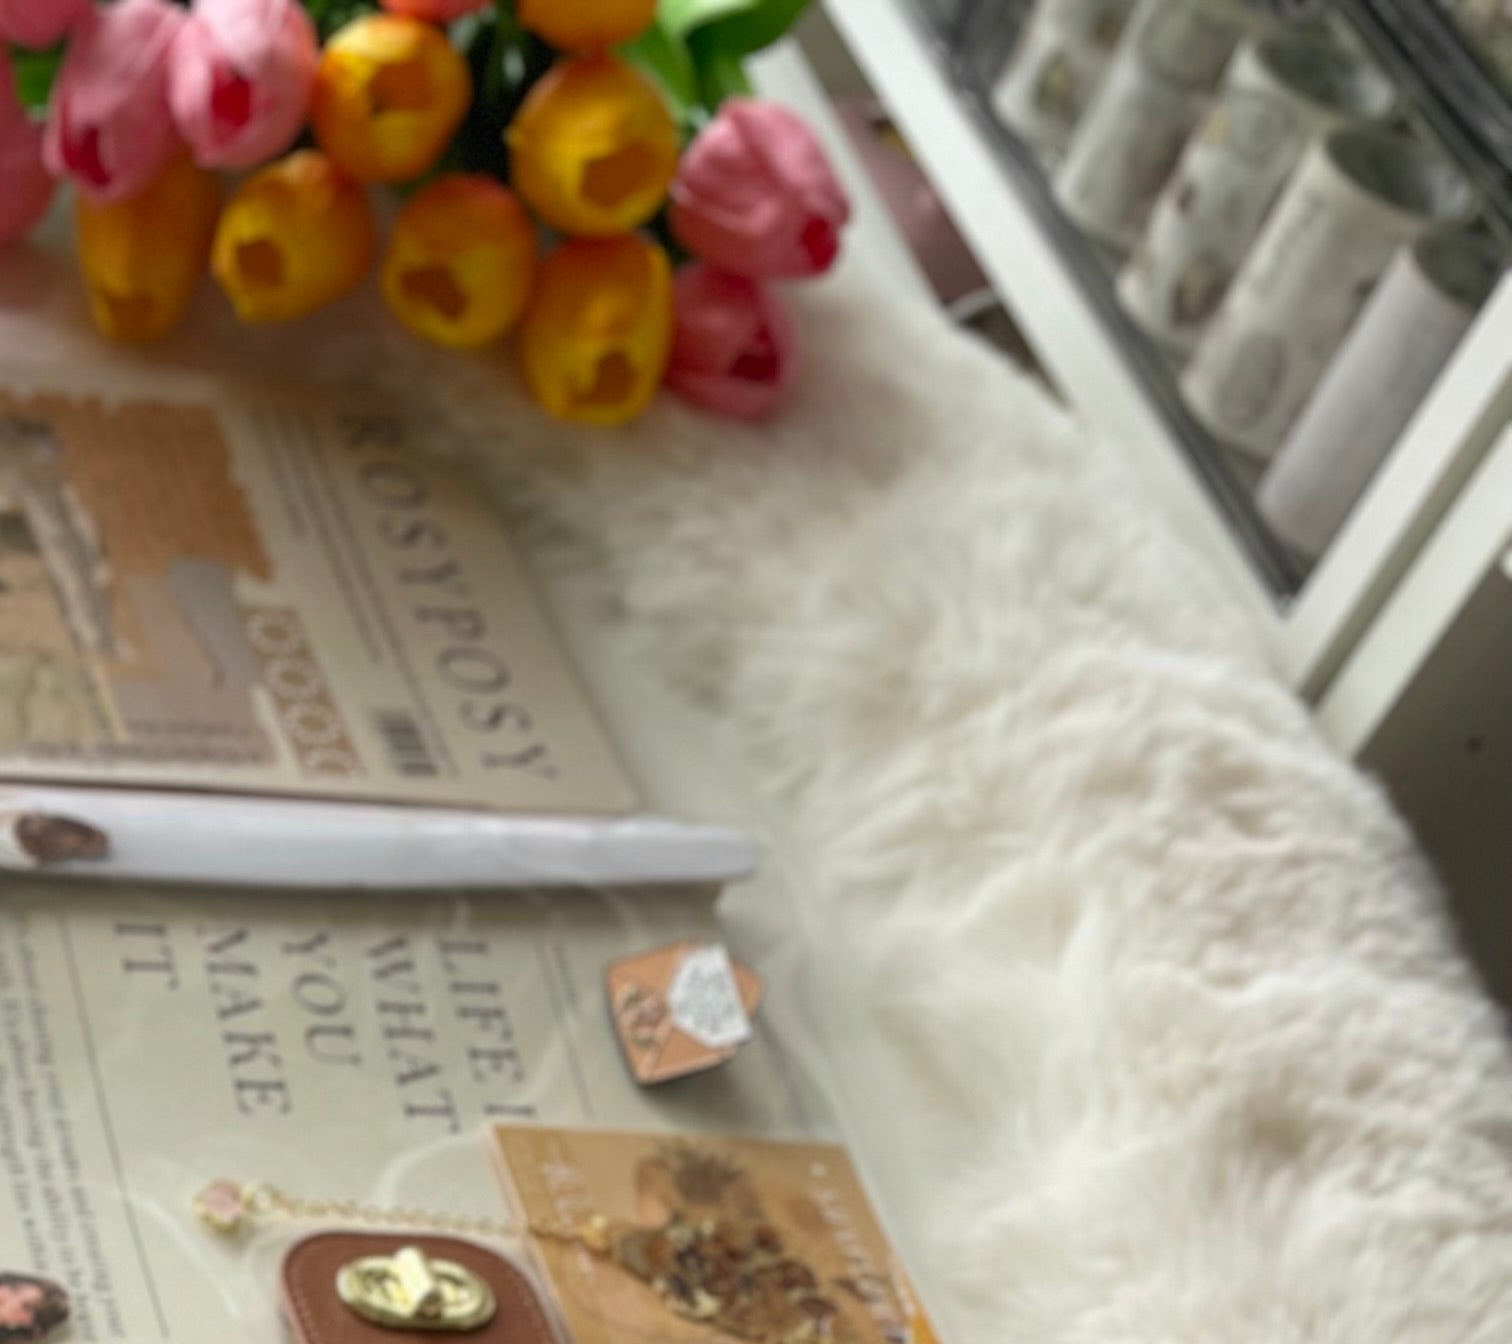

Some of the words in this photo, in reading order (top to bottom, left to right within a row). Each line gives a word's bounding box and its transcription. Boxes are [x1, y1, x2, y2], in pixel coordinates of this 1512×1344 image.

[114, 922, 179, 992] IT
[195, 925, 293, 1117] MAKE
[281, 930, 363, 1067] YOU
[439, 939, 524, 1084] LIFE
[367, 934, 461, 1135] WHAT
